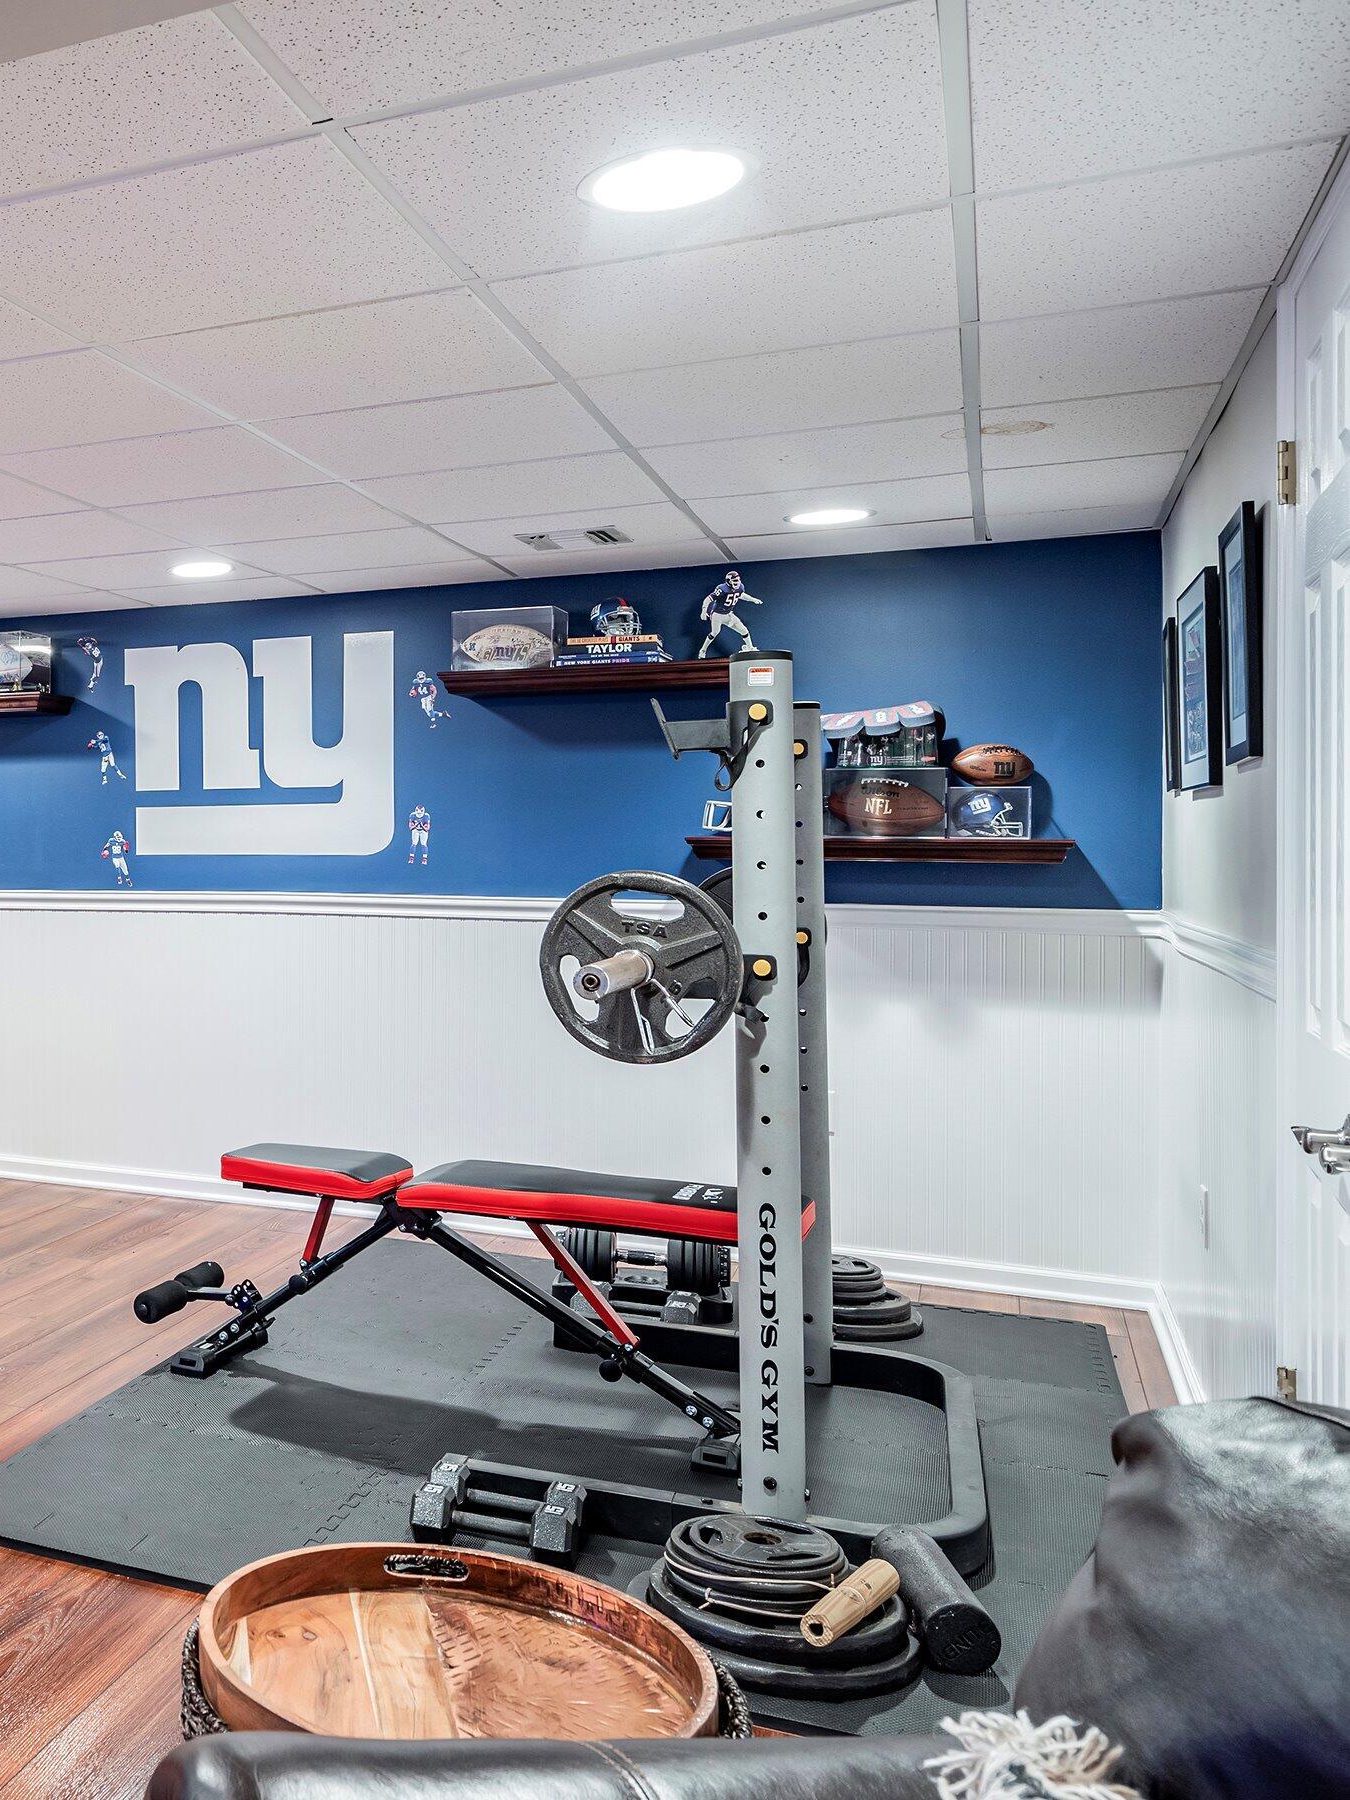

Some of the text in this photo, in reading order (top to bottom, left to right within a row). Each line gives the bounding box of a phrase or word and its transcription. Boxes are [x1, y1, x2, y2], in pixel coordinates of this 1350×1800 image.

[724, 593, 740, 607] 56
[585, 643, 632, 654] TAYLOR
[124, 630, 395, 856] ny
[994, 762, 1016, 778] ny
[865, 798, 892, 815] NFL
[968, 797, 992, 815] ny
[758, 1202, 780, 1454] GOLD'S GYM
